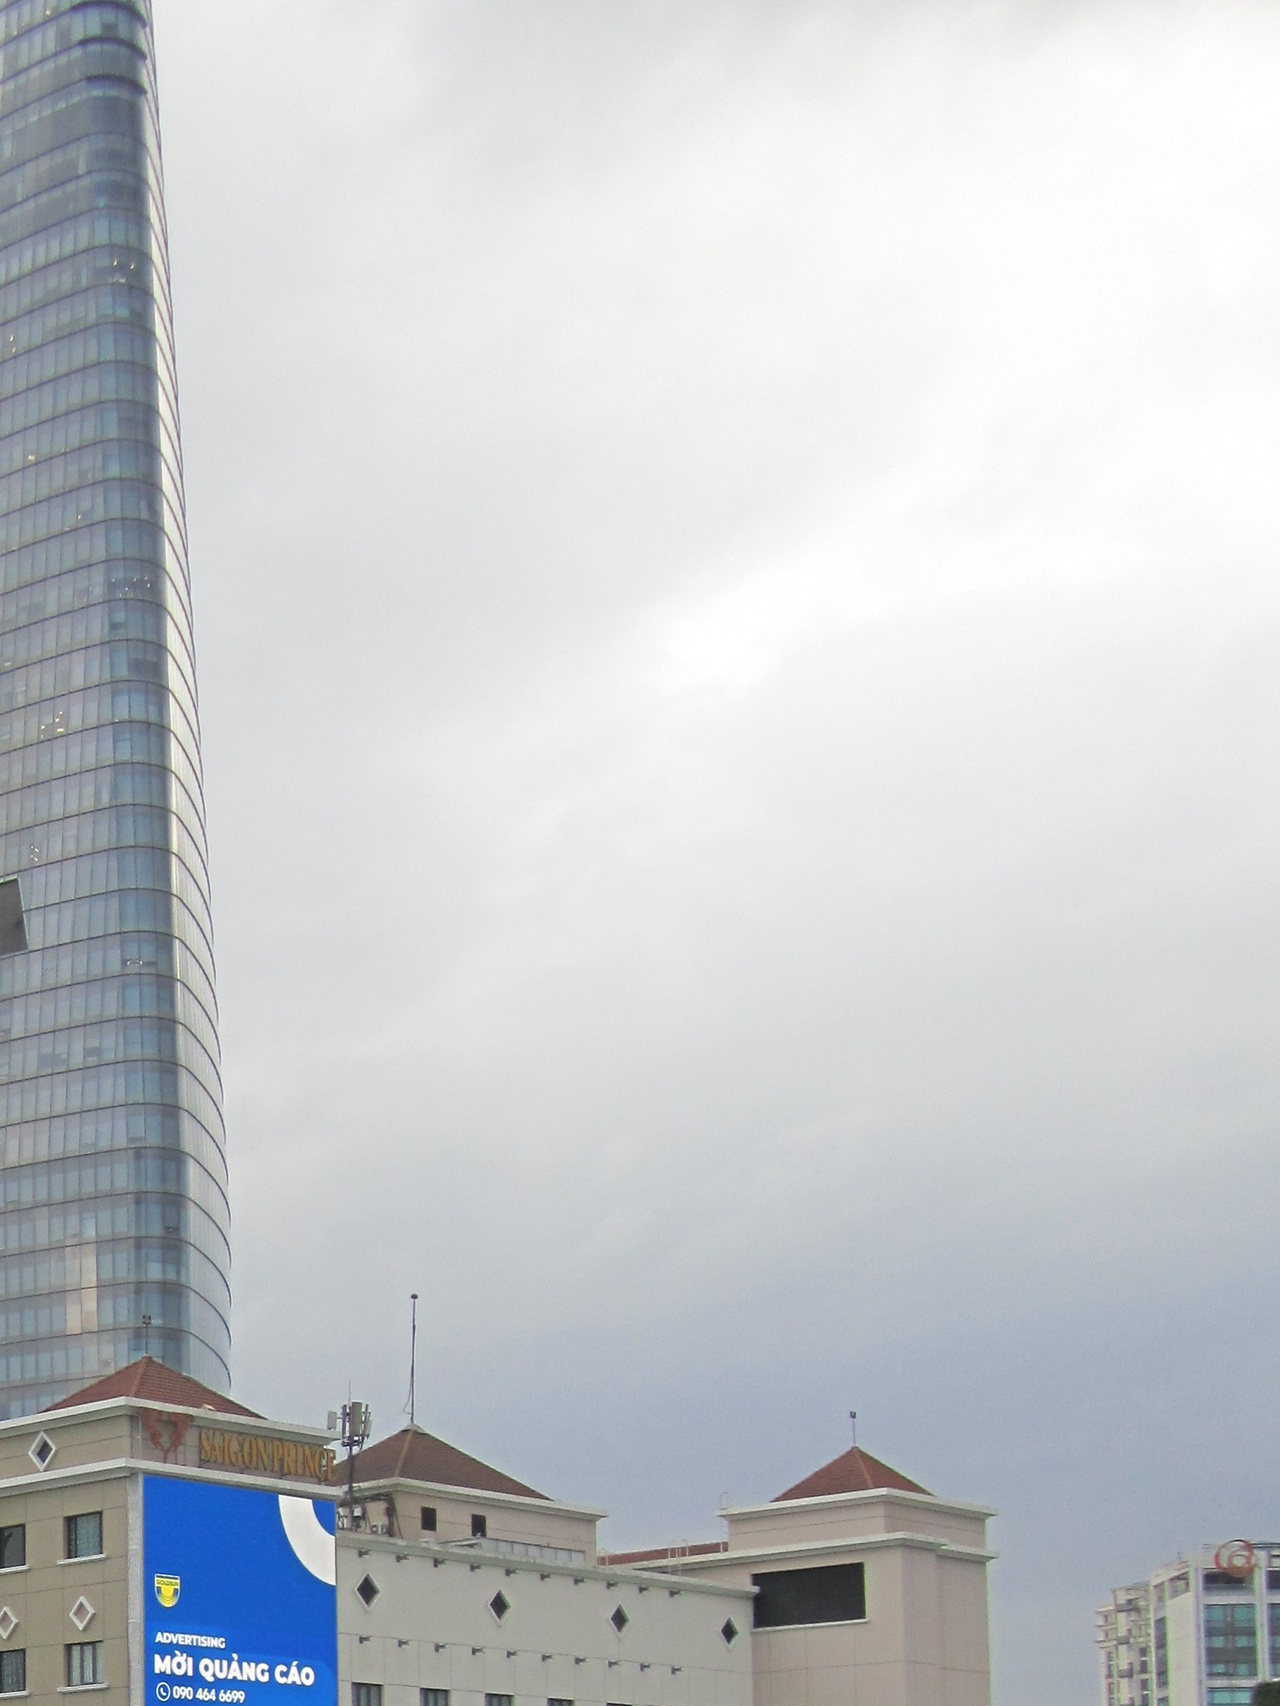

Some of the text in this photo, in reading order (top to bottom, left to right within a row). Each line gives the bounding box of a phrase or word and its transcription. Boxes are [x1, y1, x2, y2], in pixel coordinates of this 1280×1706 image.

[200, 1429, 337, 1483] SAIGON PRINCE
[155, 1631, 226, 1649] ADVERTISING
[154, 1650, 315, 1686] MỜI QUẢNG CÁO
[172, 1685, 246, 1703] 090 464 6699
